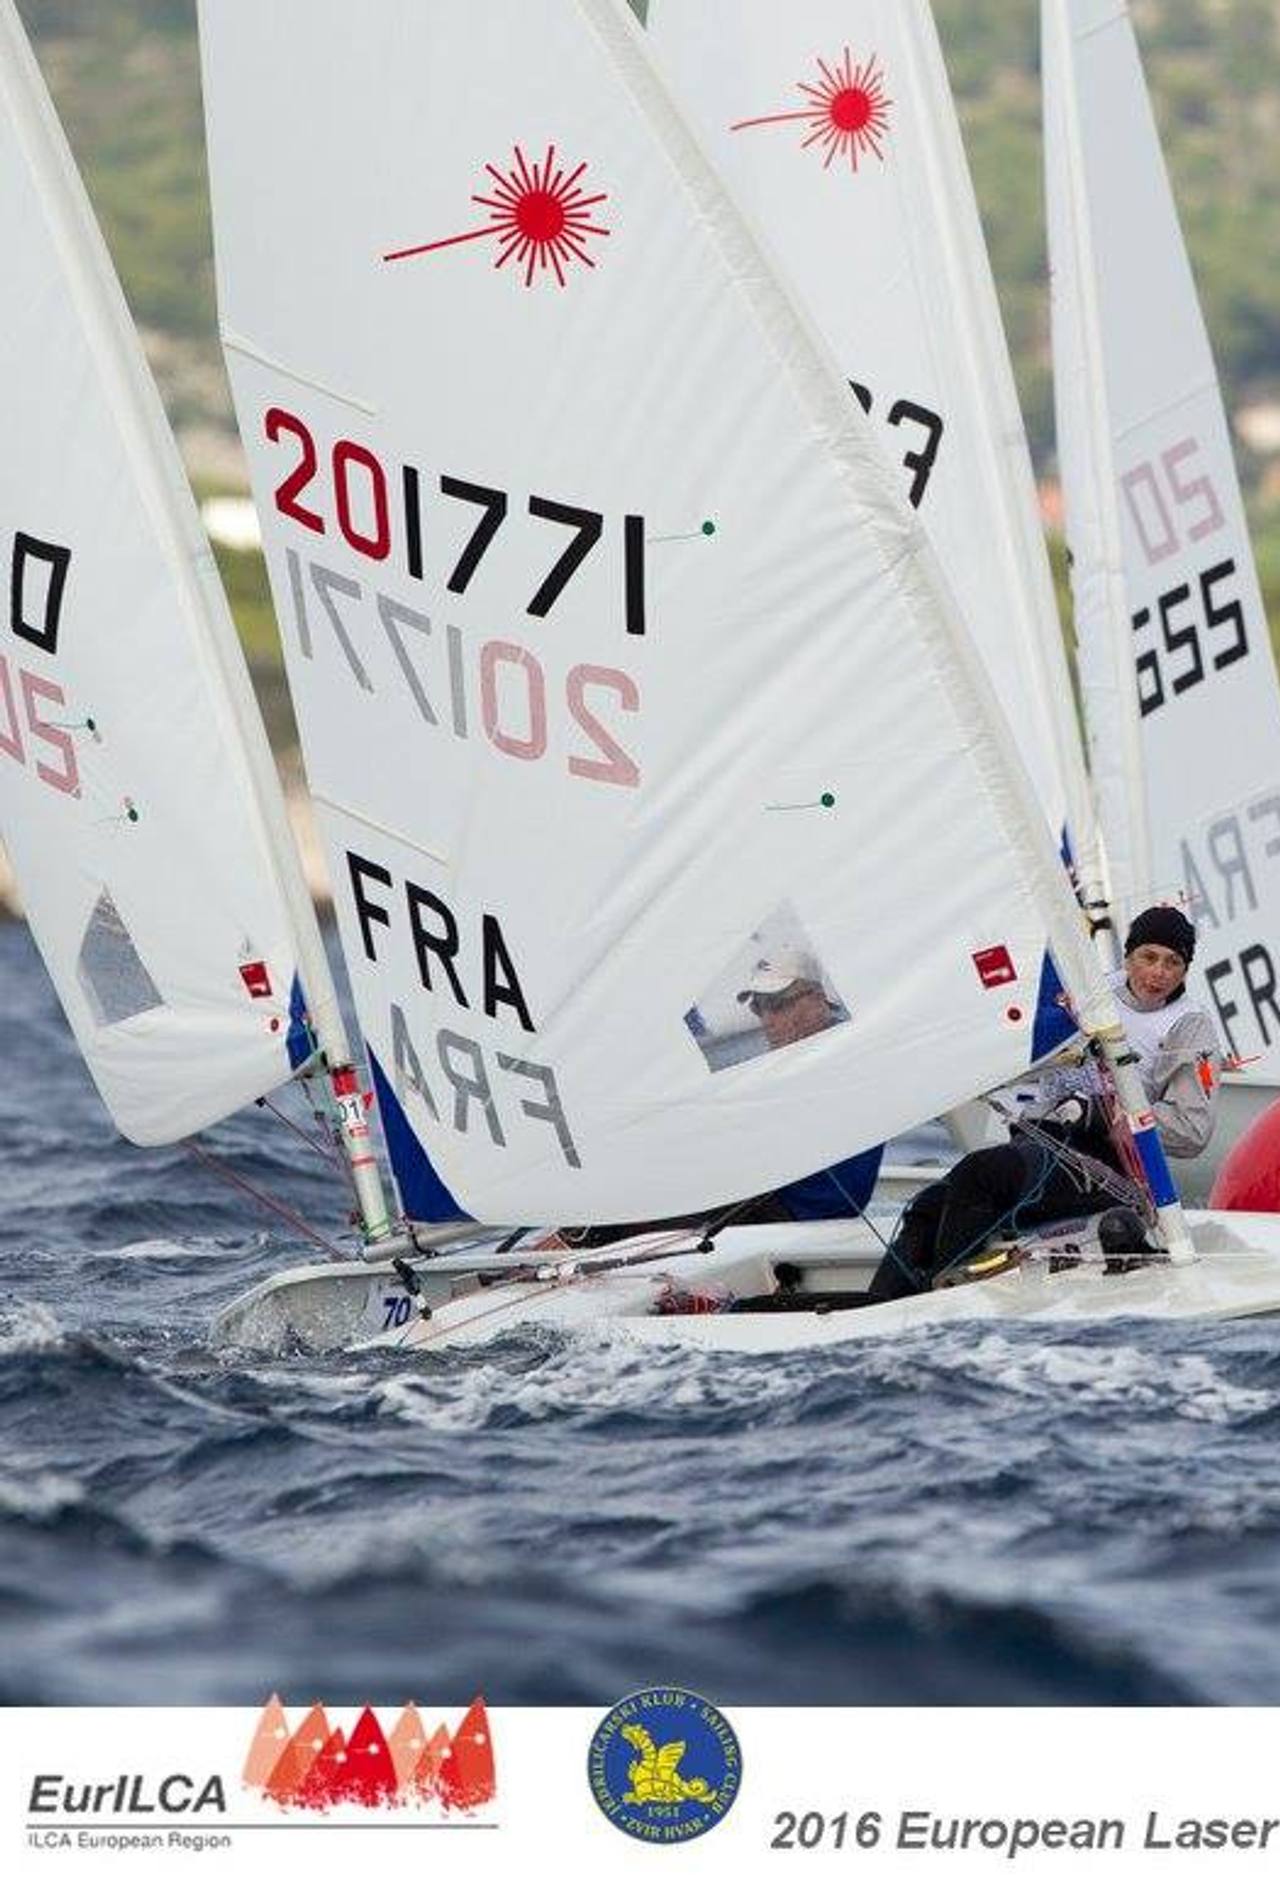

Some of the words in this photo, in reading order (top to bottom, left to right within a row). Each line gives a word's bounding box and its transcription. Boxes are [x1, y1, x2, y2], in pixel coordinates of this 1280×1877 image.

[264, 407, 645, 636] 201771
[848, 378, 943, 510] 3
[346, 850, 536, 1033] FRA
[383, 1296, 411, 1331] 70
